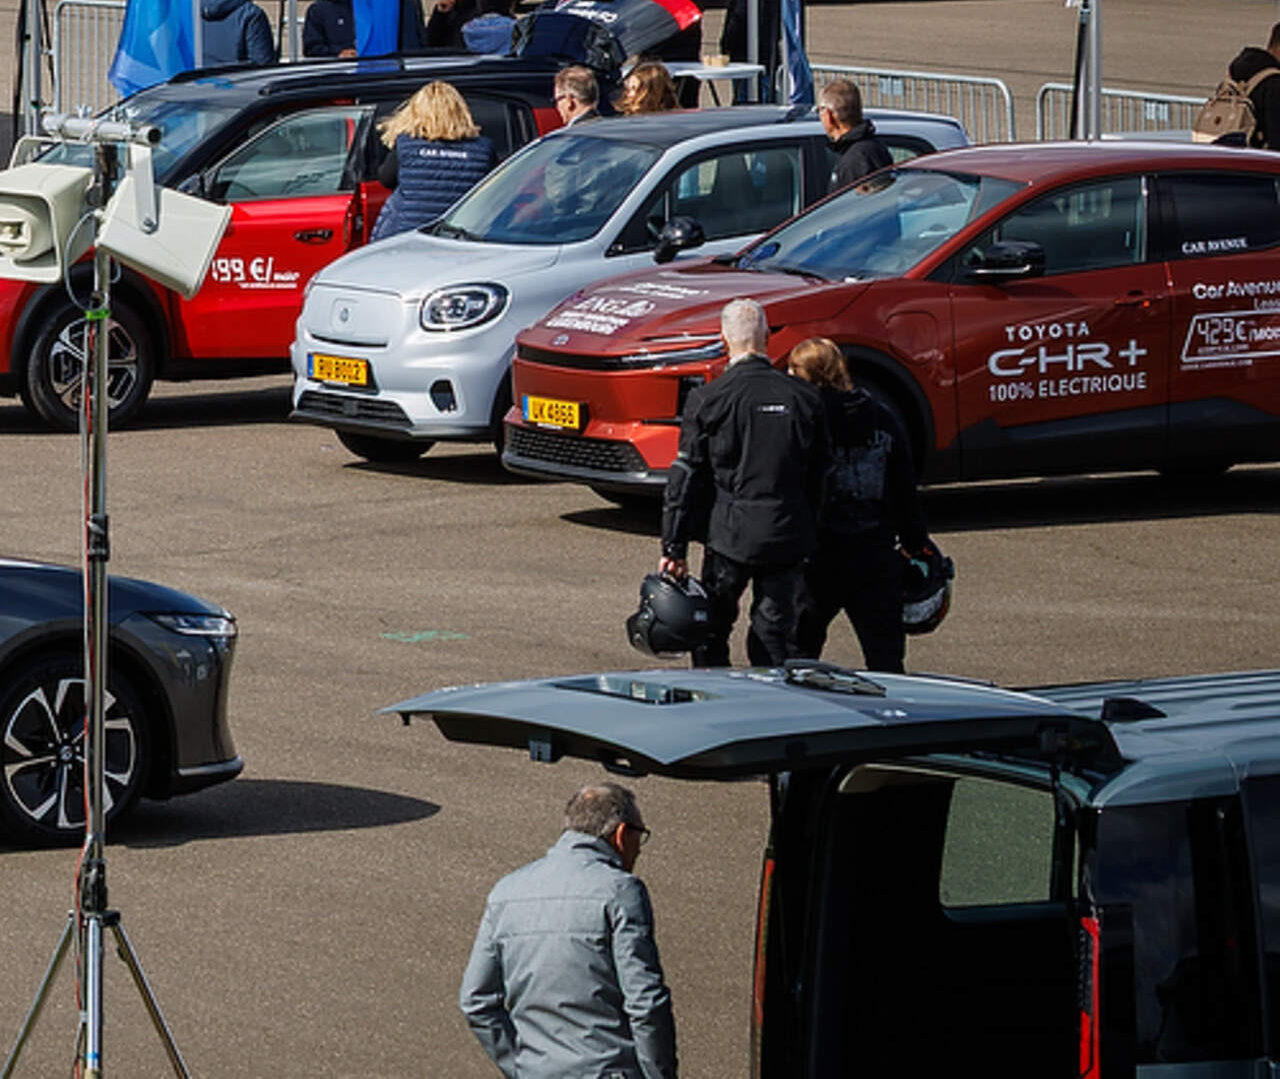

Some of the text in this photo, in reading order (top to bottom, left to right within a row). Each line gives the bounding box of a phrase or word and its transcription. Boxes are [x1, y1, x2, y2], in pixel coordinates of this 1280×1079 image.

[1005, 322, 1090, 342] TOYOTA
[989, 372, 1148, 402] 100% ELECTRIQUE
